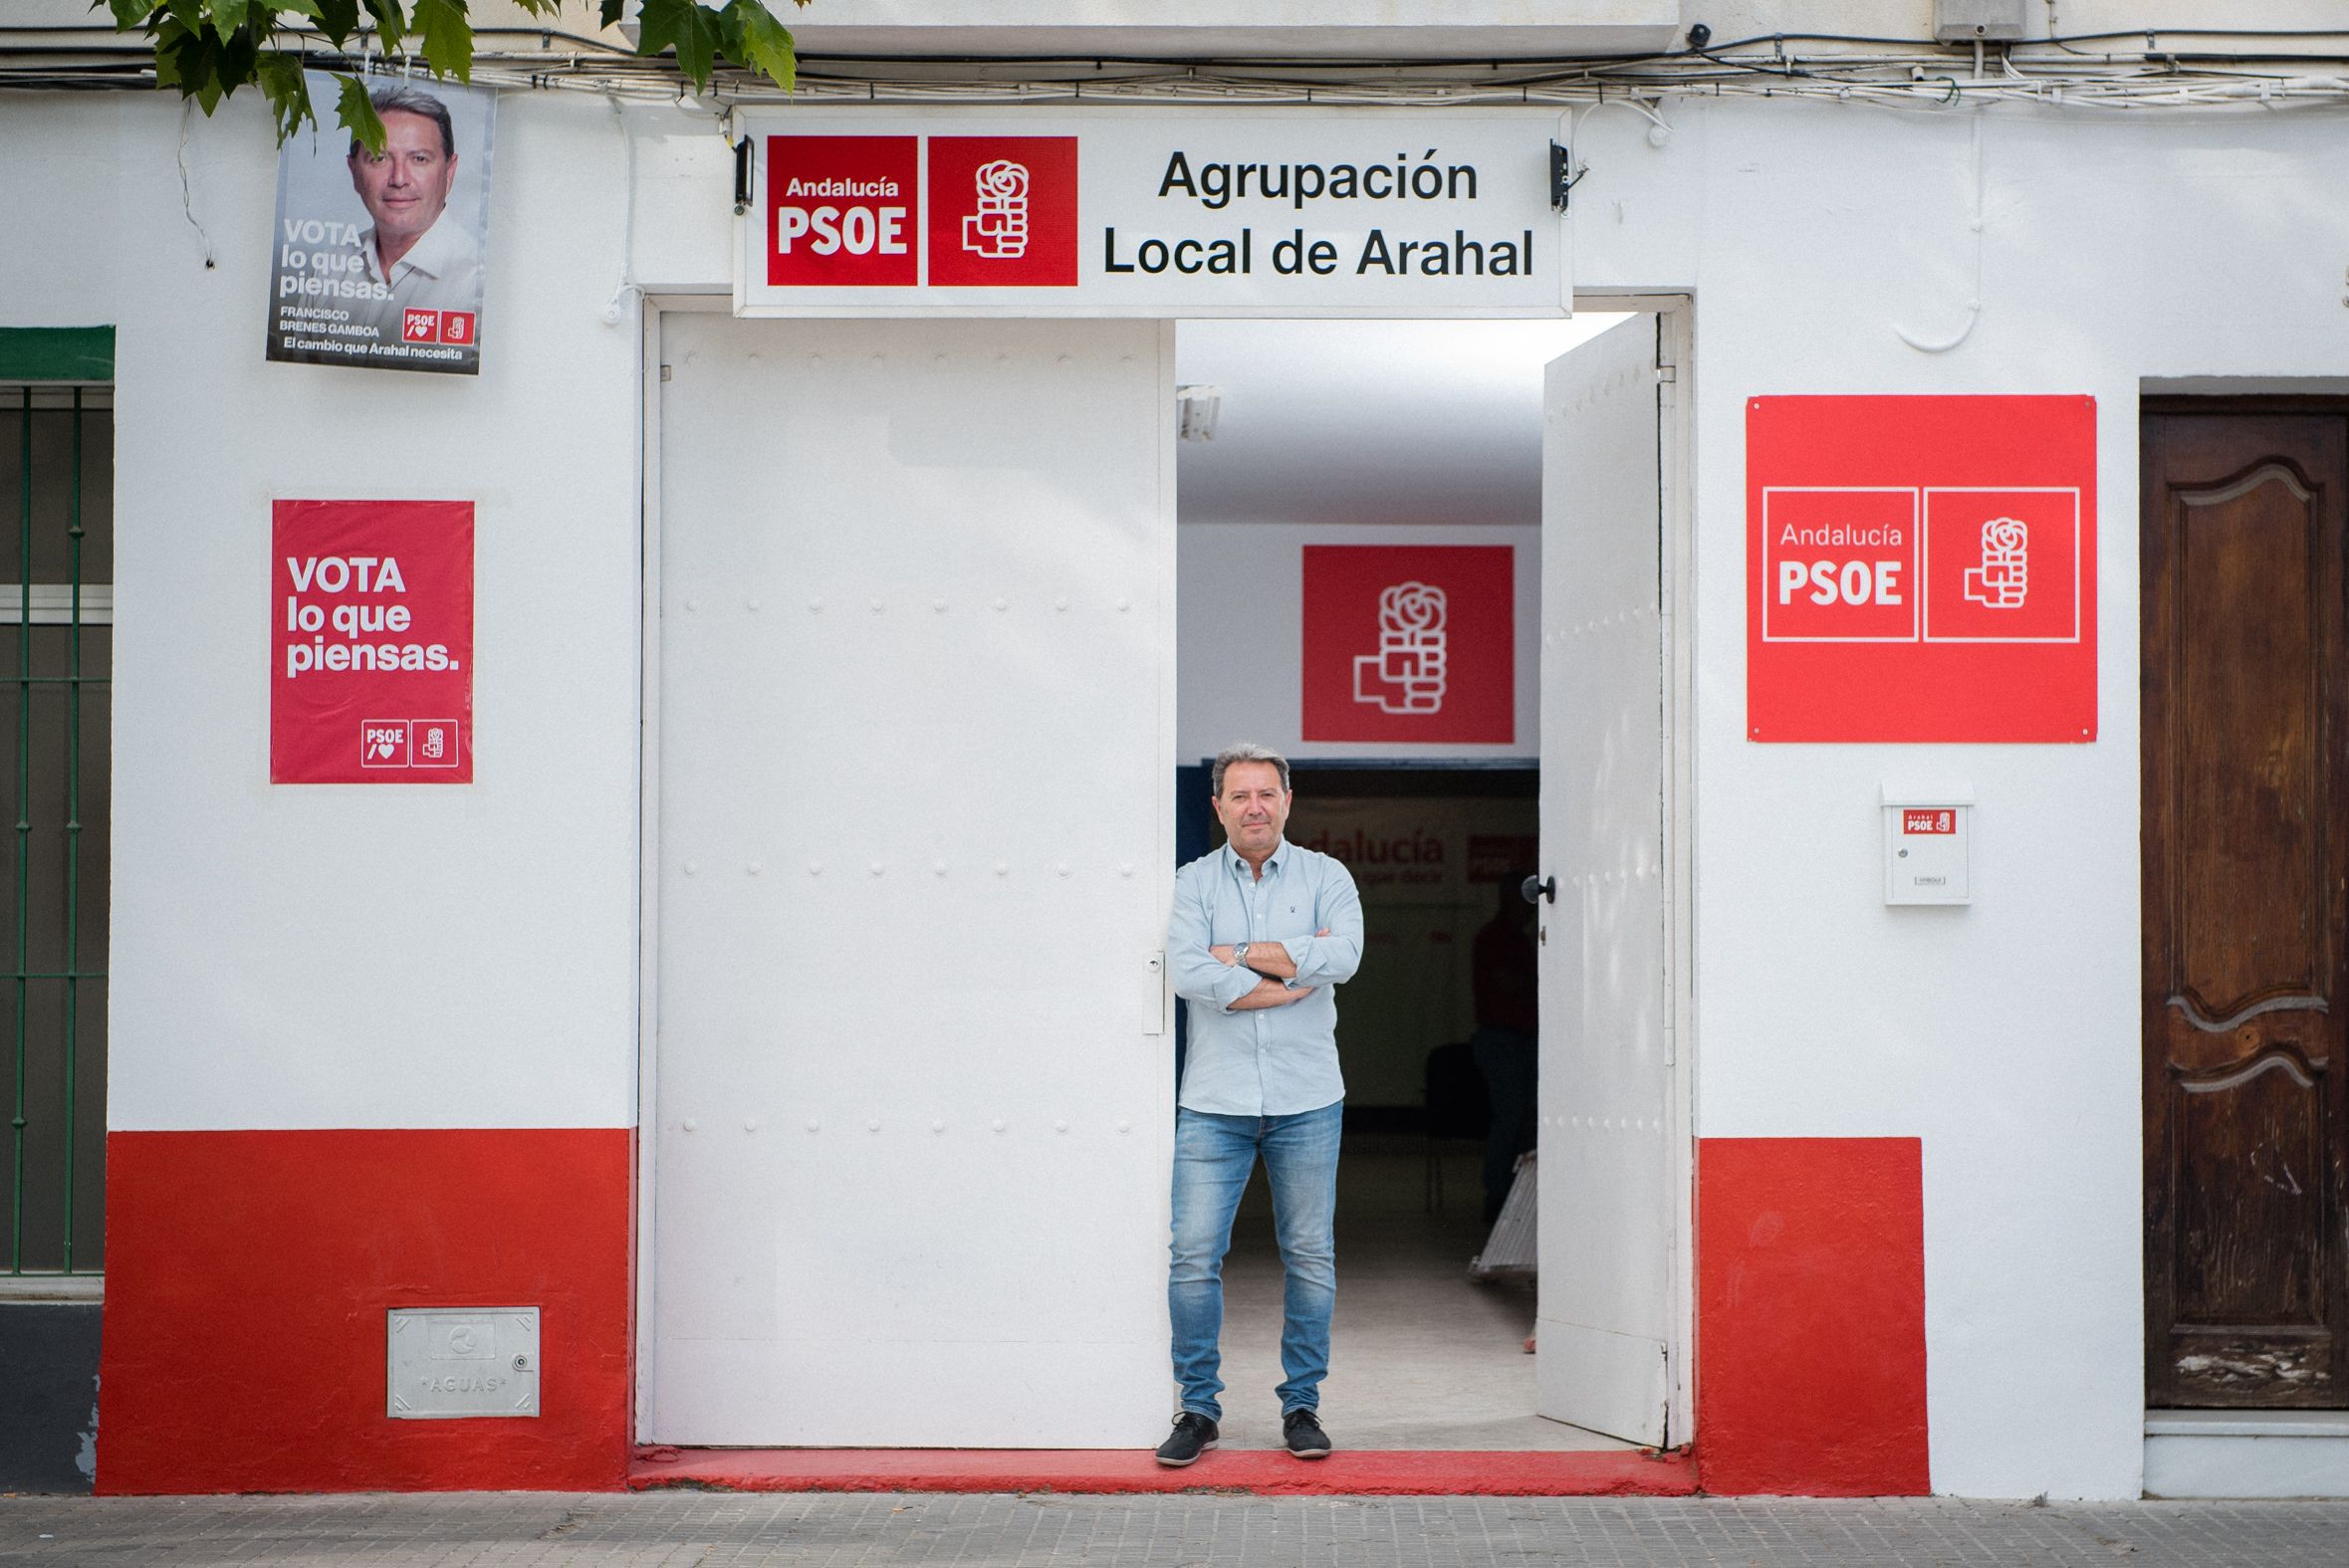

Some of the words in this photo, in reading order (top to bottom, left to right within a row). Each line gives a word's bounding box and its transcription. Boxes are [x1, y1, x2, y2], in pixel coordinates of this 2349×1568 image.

[785, 174, 899, 198] Andalucía
[1157, 148, 1477, 208] Agrupación
[284, 218, 361, 248] VOTA
[778, 205, 907, 256] PSOE
[282, 245, 307, 269] lo
[312, 252, 364, 275] que
[1104, 227, 1252, 275] Local
[1272, 228, 1337, 276] de
[1356, 228, 1532, 276] Arahal
[280, 272, 395, 301] piensas.
[279, 320, 327, 334] BRENES
[328, 324, 379, 337] GAMBOA
[280, 306, 350, 322] FRANCISCO
[406, 314, 435, 327] PSOE
[284, 336, 297, 348] El
[297, 338, 344, 352] cambio
[344, 342, 368, 355] que
[368, 342, 409, 357] Arahal
[410, 346, 463, 360] necesita
[1779, 522, 1902, 547] Andalucía
[287, 557, 406, 593] VOTA
[1778, 560, 1903, 606] PSOE
[287, 596, 325, 632] lo
[332, 603, 411, 640] que
[287, 635, 459, 679] piensas.
[366, 728, 404, 744] PSOE
[1907, 820, 1934, 831] PSOE
[1292, 827, 1444, 863] dalucía
